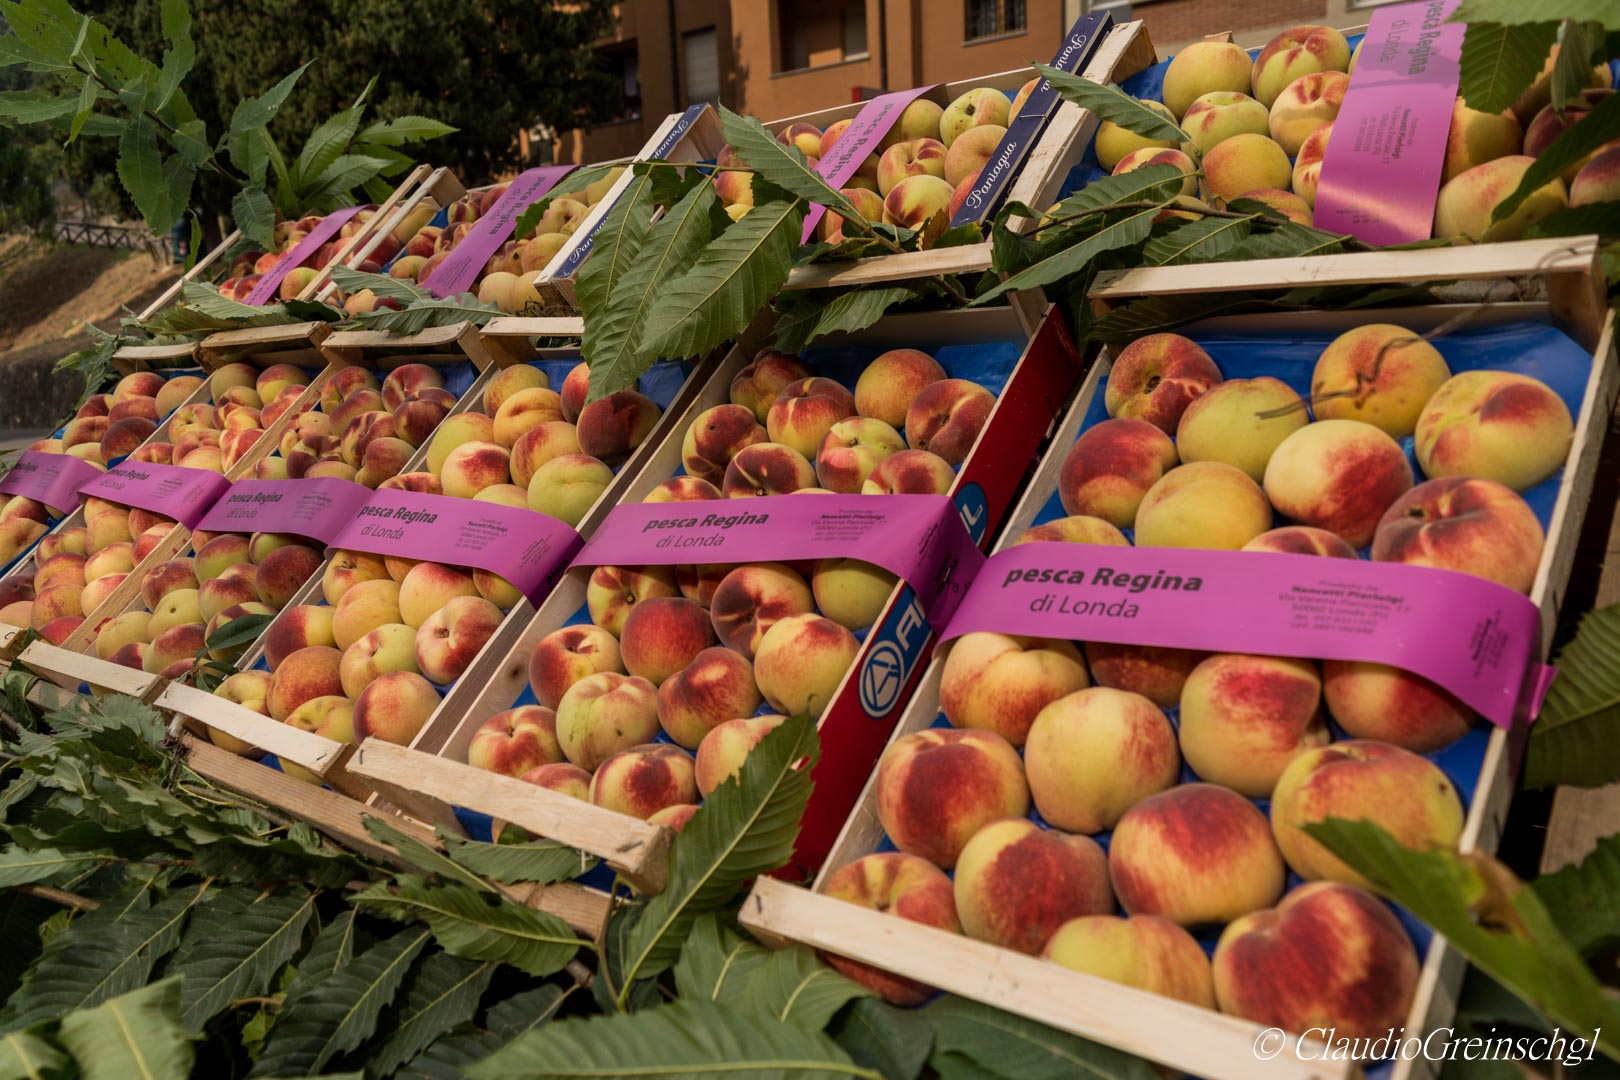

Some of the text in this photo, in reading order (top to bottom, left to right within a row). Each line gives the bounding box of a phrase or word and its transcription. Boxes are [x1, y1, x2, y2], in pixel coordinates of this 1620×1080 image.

[1380, 19, 1410, 62] di Londa
[1408, 1, 1444, 75] pesca Regina
[825, 132, 857, 165] Londa
[826, 103, 894, 180] pesca Regina
[966, 141, 1016, 208] Paniagua
[489, 176, 546, 235] pesca Regina
[226, 492, 283, 505] pesca Regina
[358, 505, 438, 524] pesca Regina
[642, 512, 770, 533] pesca Regina
[361, 524, 404, 540] di Londa
[656, 532, 725, 548] di Londa
[1002, 567, 1203, 593] pesca Regina
[1030, 594, 1140, 618] di Londa
